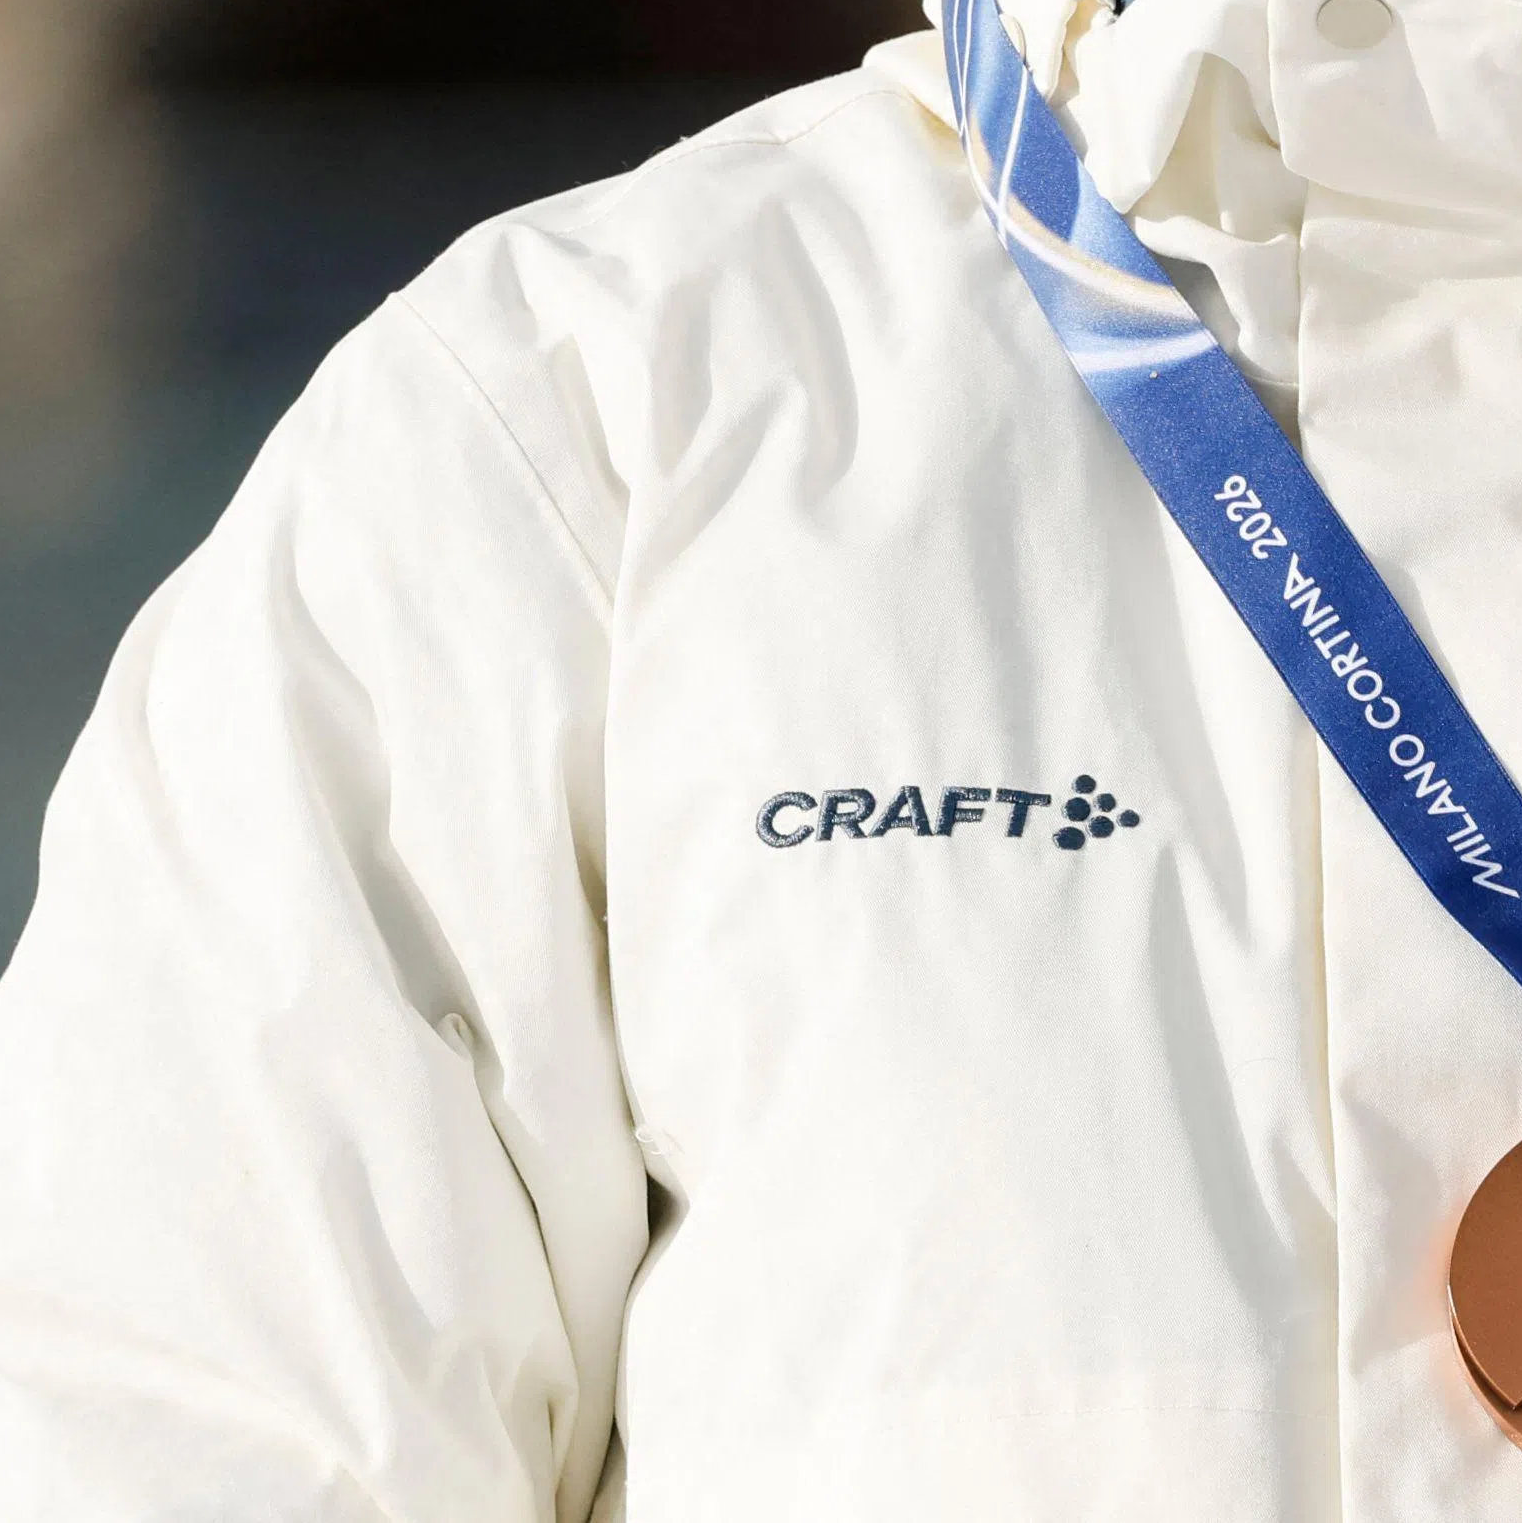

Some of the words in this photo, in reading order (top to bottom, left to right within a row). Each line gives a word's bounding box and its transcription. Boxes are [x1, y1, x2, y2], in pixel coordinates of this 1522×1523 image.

[1214, 474, 1288, 560] 2026
[1283, 551, 1401, 730] CORTINA
[756, 785, 1051, 849] CRAFT
[1388, 733, 1520, 898] MILANO
